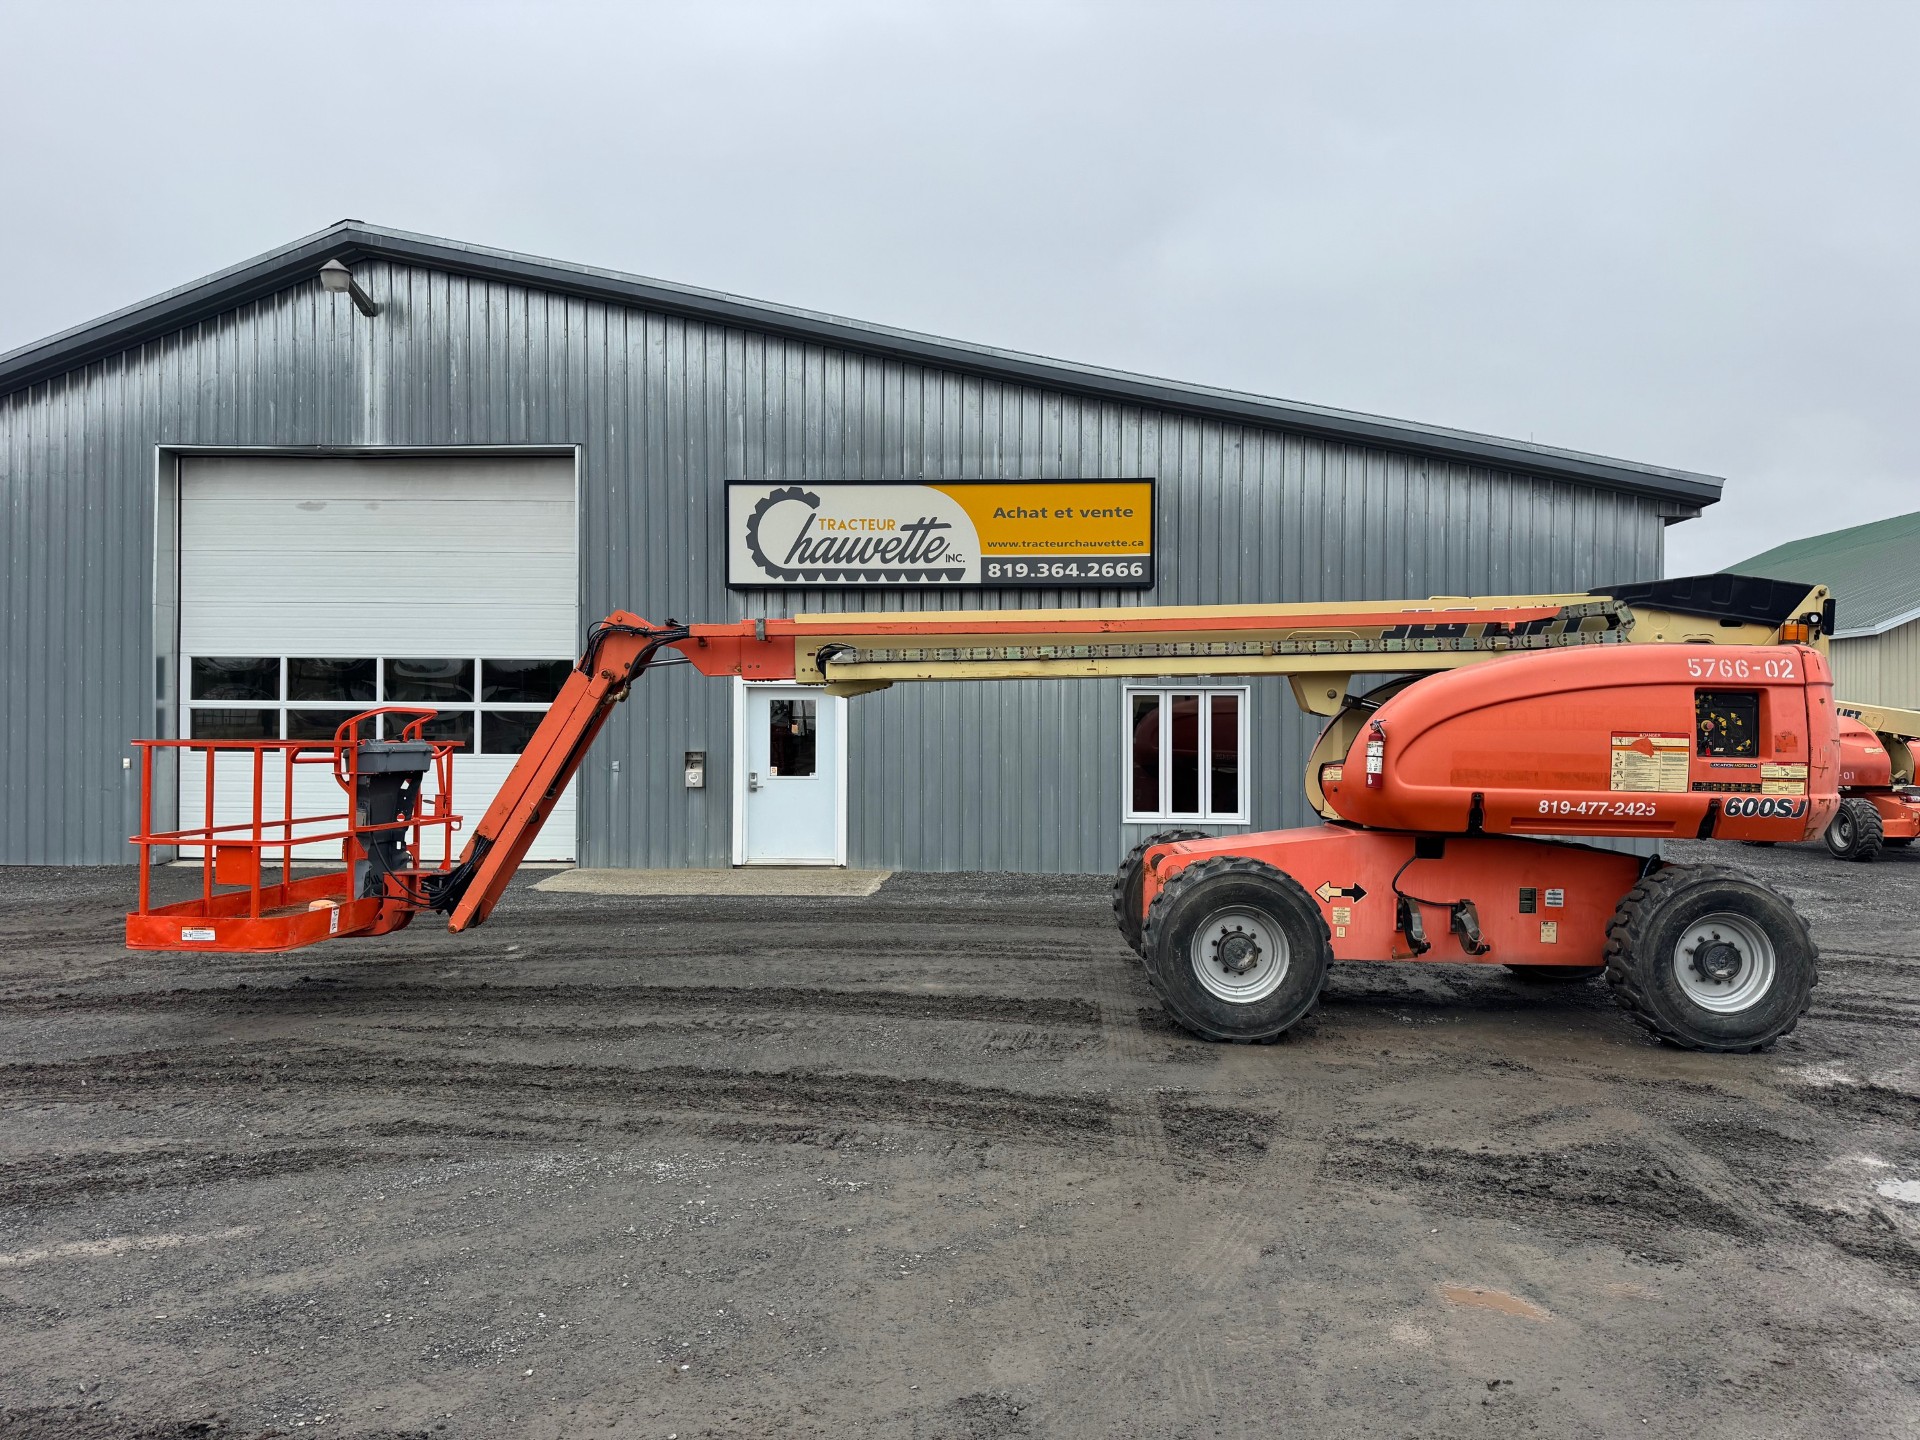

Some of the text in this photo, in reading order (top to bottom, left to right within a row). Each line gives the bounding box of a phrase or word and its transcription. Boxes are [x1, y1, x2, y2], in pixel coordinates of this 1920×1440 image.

[992, 506, 1134, 519] Achat et vente
[818, 518, 896, 531] TRACTEUR
[746, 486, 966, 581] Chauvette INC.
[987, 539, 1144, 548] www.tracteurchauvette.ca
[987, 562, 1144, 578] 819.364.2666
[1687, 658, 1795, 679] 5766-02
[1538, 799, 1657, 816] 819-477-2425
[1723, 796, 1809, 819] 600SJ
